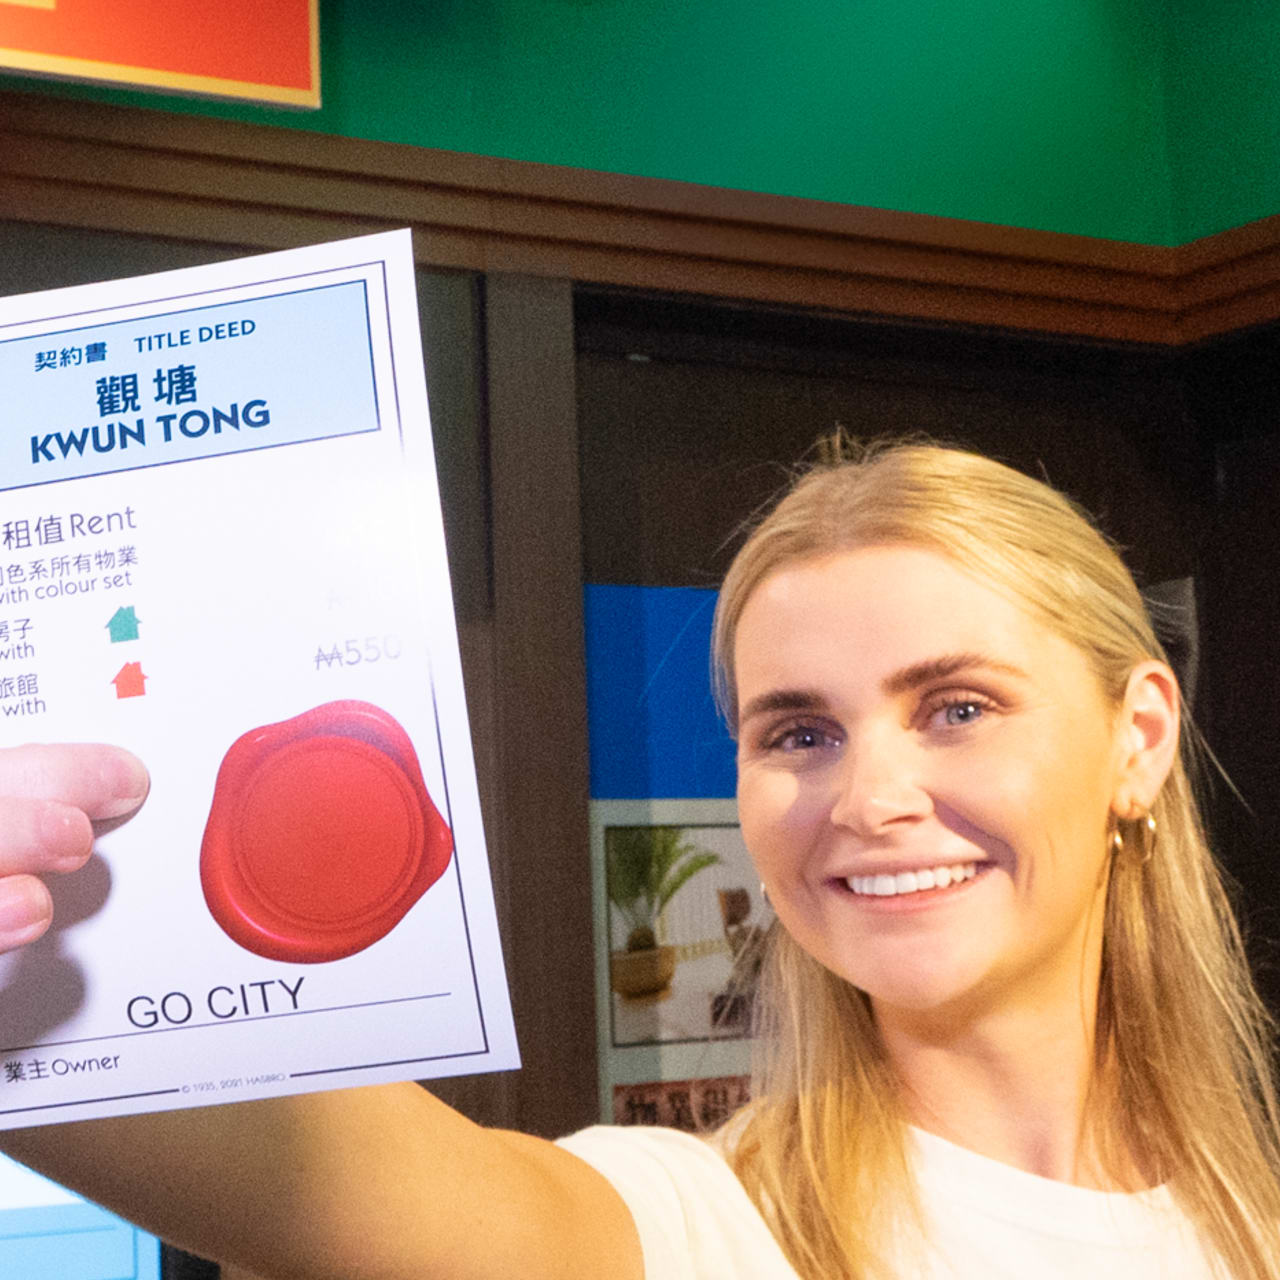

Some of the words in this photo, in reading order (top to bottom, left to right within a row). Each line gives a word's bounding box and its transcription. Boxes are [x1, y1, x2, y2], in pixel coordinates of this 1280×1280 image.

[35, 341, 108, 372] 契約書
[134, 329, 191, 353] TITLE
[198, 319, 256, 343] DEED
[95, 363, 198, 418] 觀塘
[30, 418, 146, 464] KWUN
[155, 399, 271, 443] TONG
[70, 506, 138, 538] Rent
[34, 578, 97, 600] colour
[103, 570, 133, 590] set
[2, 697, 47, 717] with
[126, 991, 193, 1029] GO
[206, 976, 306, 1019] CITY
[51, 1054, 121, 1076] Owner
